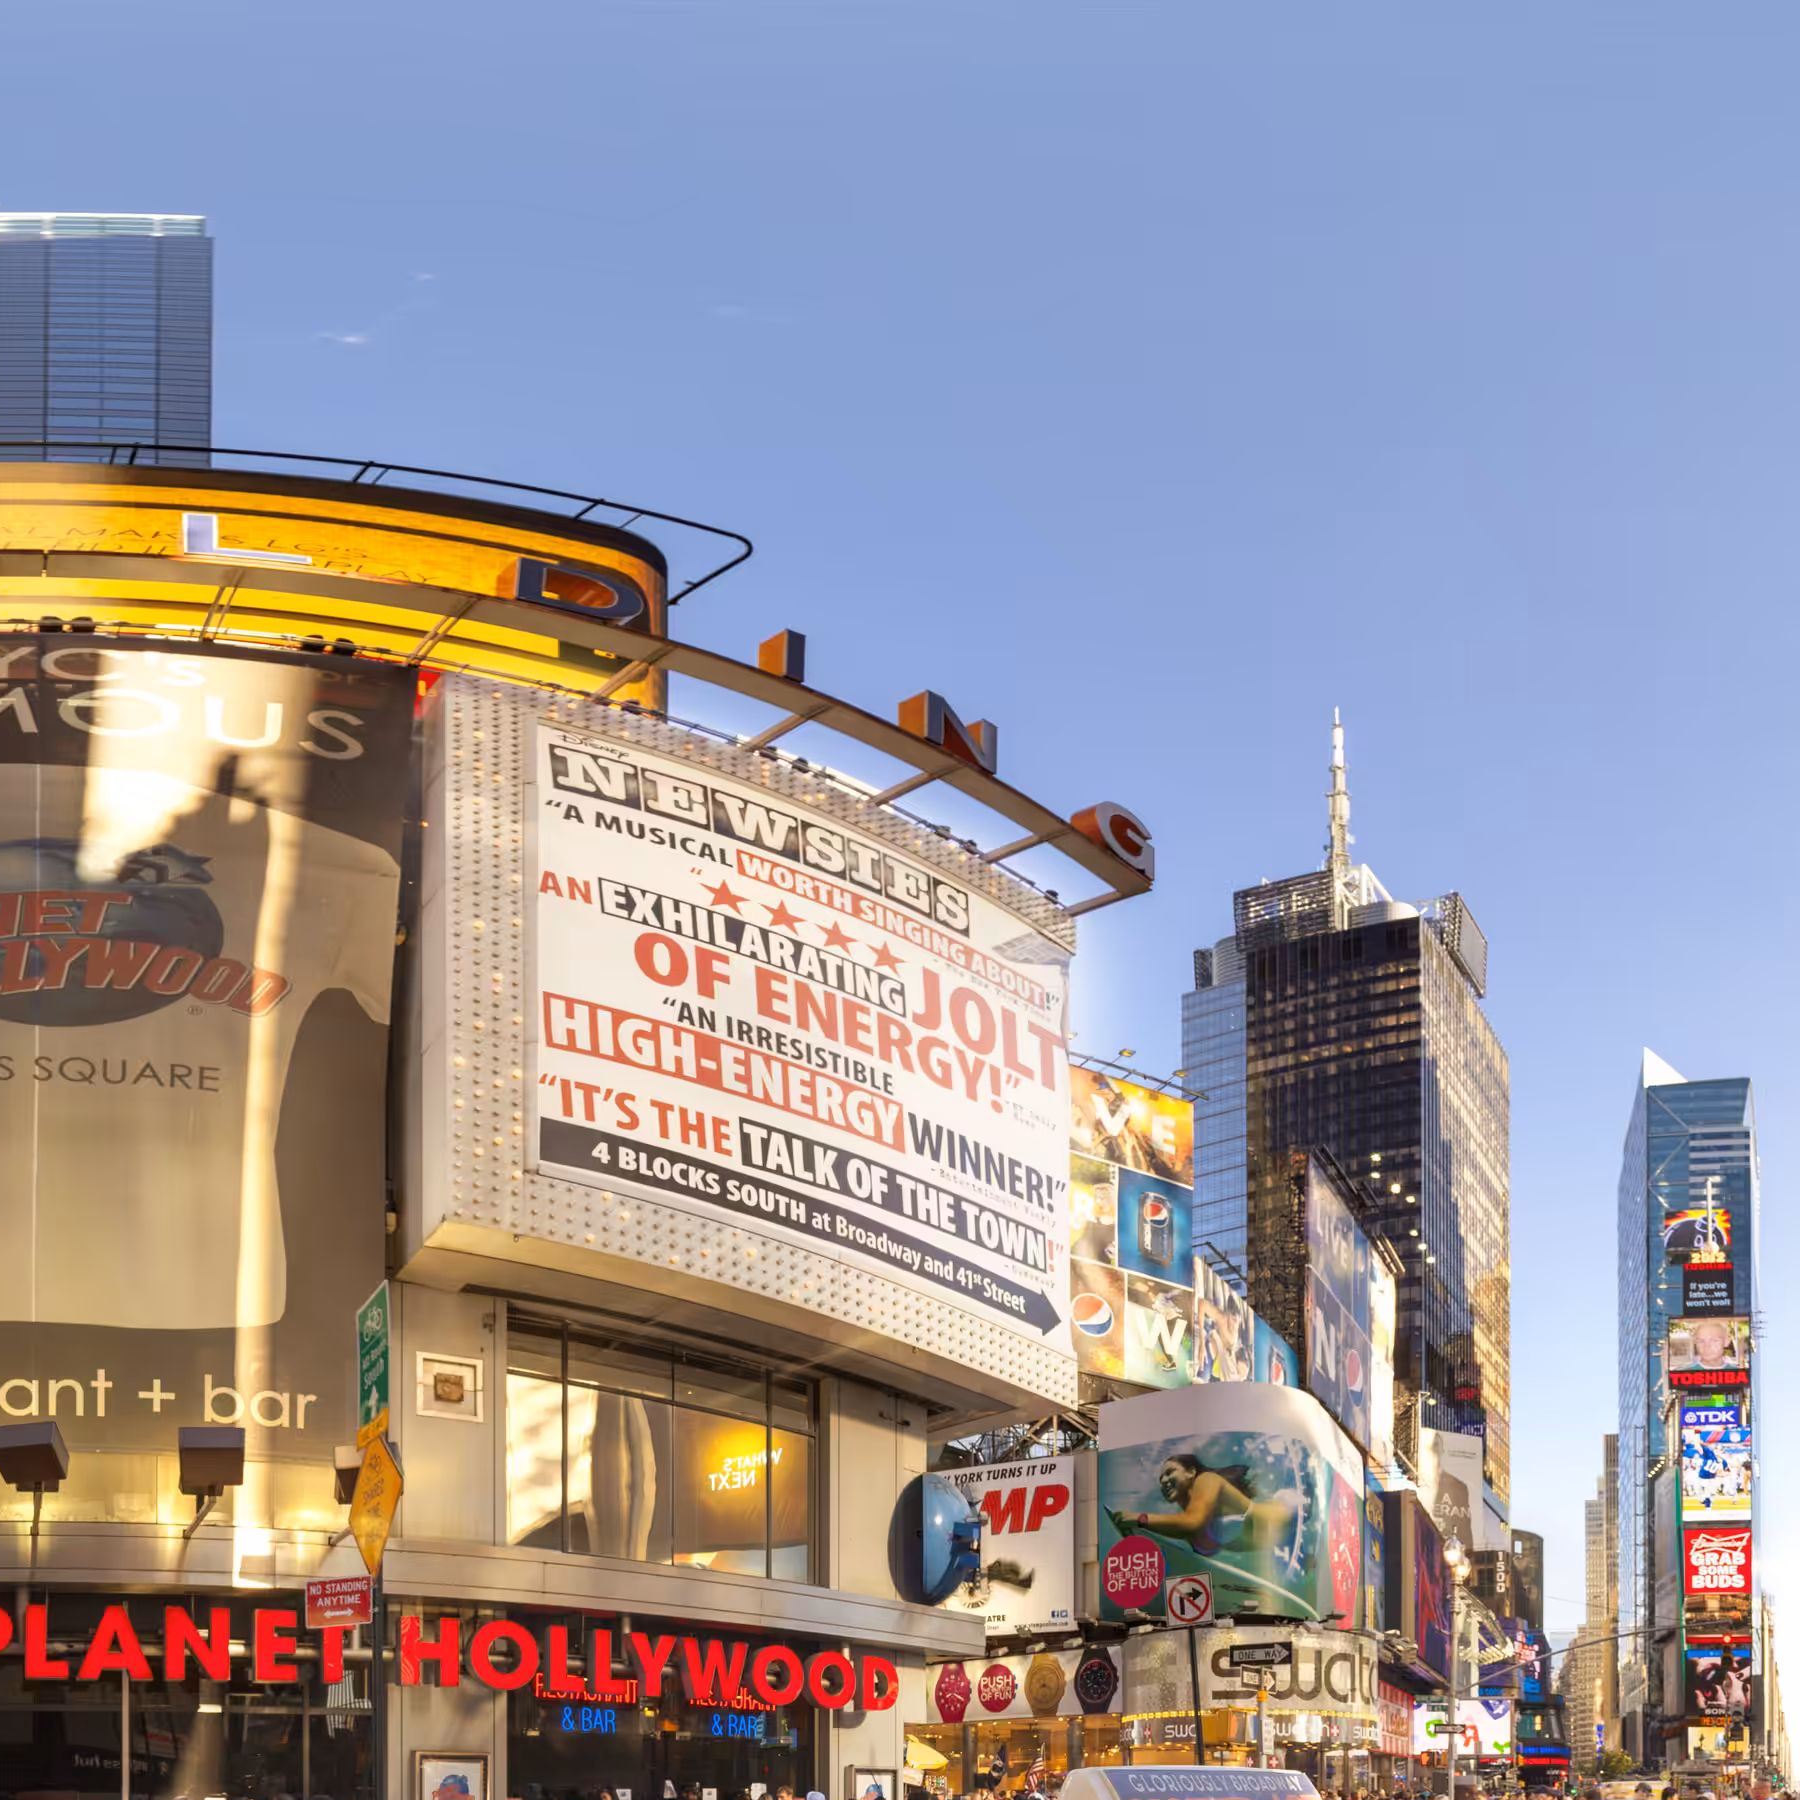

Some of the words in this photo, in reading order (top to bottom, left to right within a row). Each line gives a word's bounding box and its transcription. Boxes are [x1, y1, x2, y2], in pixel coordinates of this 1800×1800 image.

[549, 743, 970, 938] NEWSIES
[539, 870, 593, 905] AN
[609, 880, 903, 1018] EXHILARATING
[912, 968, 1066, 1093] JOLT
[34, 1056, 222, 1093] SQUARE
[591, 1140, 612, 1166] 4
[618, 1147, 720, 1197] BLOCKS
[726, 1178, 807, 1226] SOUTH
[812, 1211, 832, 1233] at
[836, 1213, 921, 1273] Broadway
[923, 1252, 954, 1283] and
[956, 1261, 982, 1293] 41st
[982, 1274, 1027, 1315] Street
[1669, 1371, 1749, 1387] TOSHIBA
[138, 1378, 176, 1413] +
[203, 1374, 318, 1429] bar
[1695, 1411, 1737, 1424] TDK
[953, 1469, 984, 1485] YORK
[986, 1465, 1023, 1482] TURNS
[1026, 1464, 1037, 1477] IT
[1040, 1462, 1057, 1476] UP
[1107, 1551, 1159, 1571] PUSH
[1690, 1552, 1746, 1567] GRAB
[1108, 1571, 1128, 1580] THE
[1128, 1568, 1160, 1580] BUTTON
[1698, 1566, 1738, 1576] SOME
[310, 1584, 323, 1596] NO
[325, 1578, 369, 1594] STANDING
[1107, 1578, 1129, 1593] OF
[1130, 1575, 1160, 1591] FUN
[1691, 1575, 1746, 1589] BUDS
[317, 1593, 362, 1608] ANYTIME
[399, 1614, 900, 1713] HOLLYWOOD
[1238, 1650, 1257, 1661] ONE
[1265, 1649, 1283, 1659] WAY
[1129, 1774, 1228, 1794] GLORIOUSLY
[1230, 1774, 1302, 1792] BROADWAY
